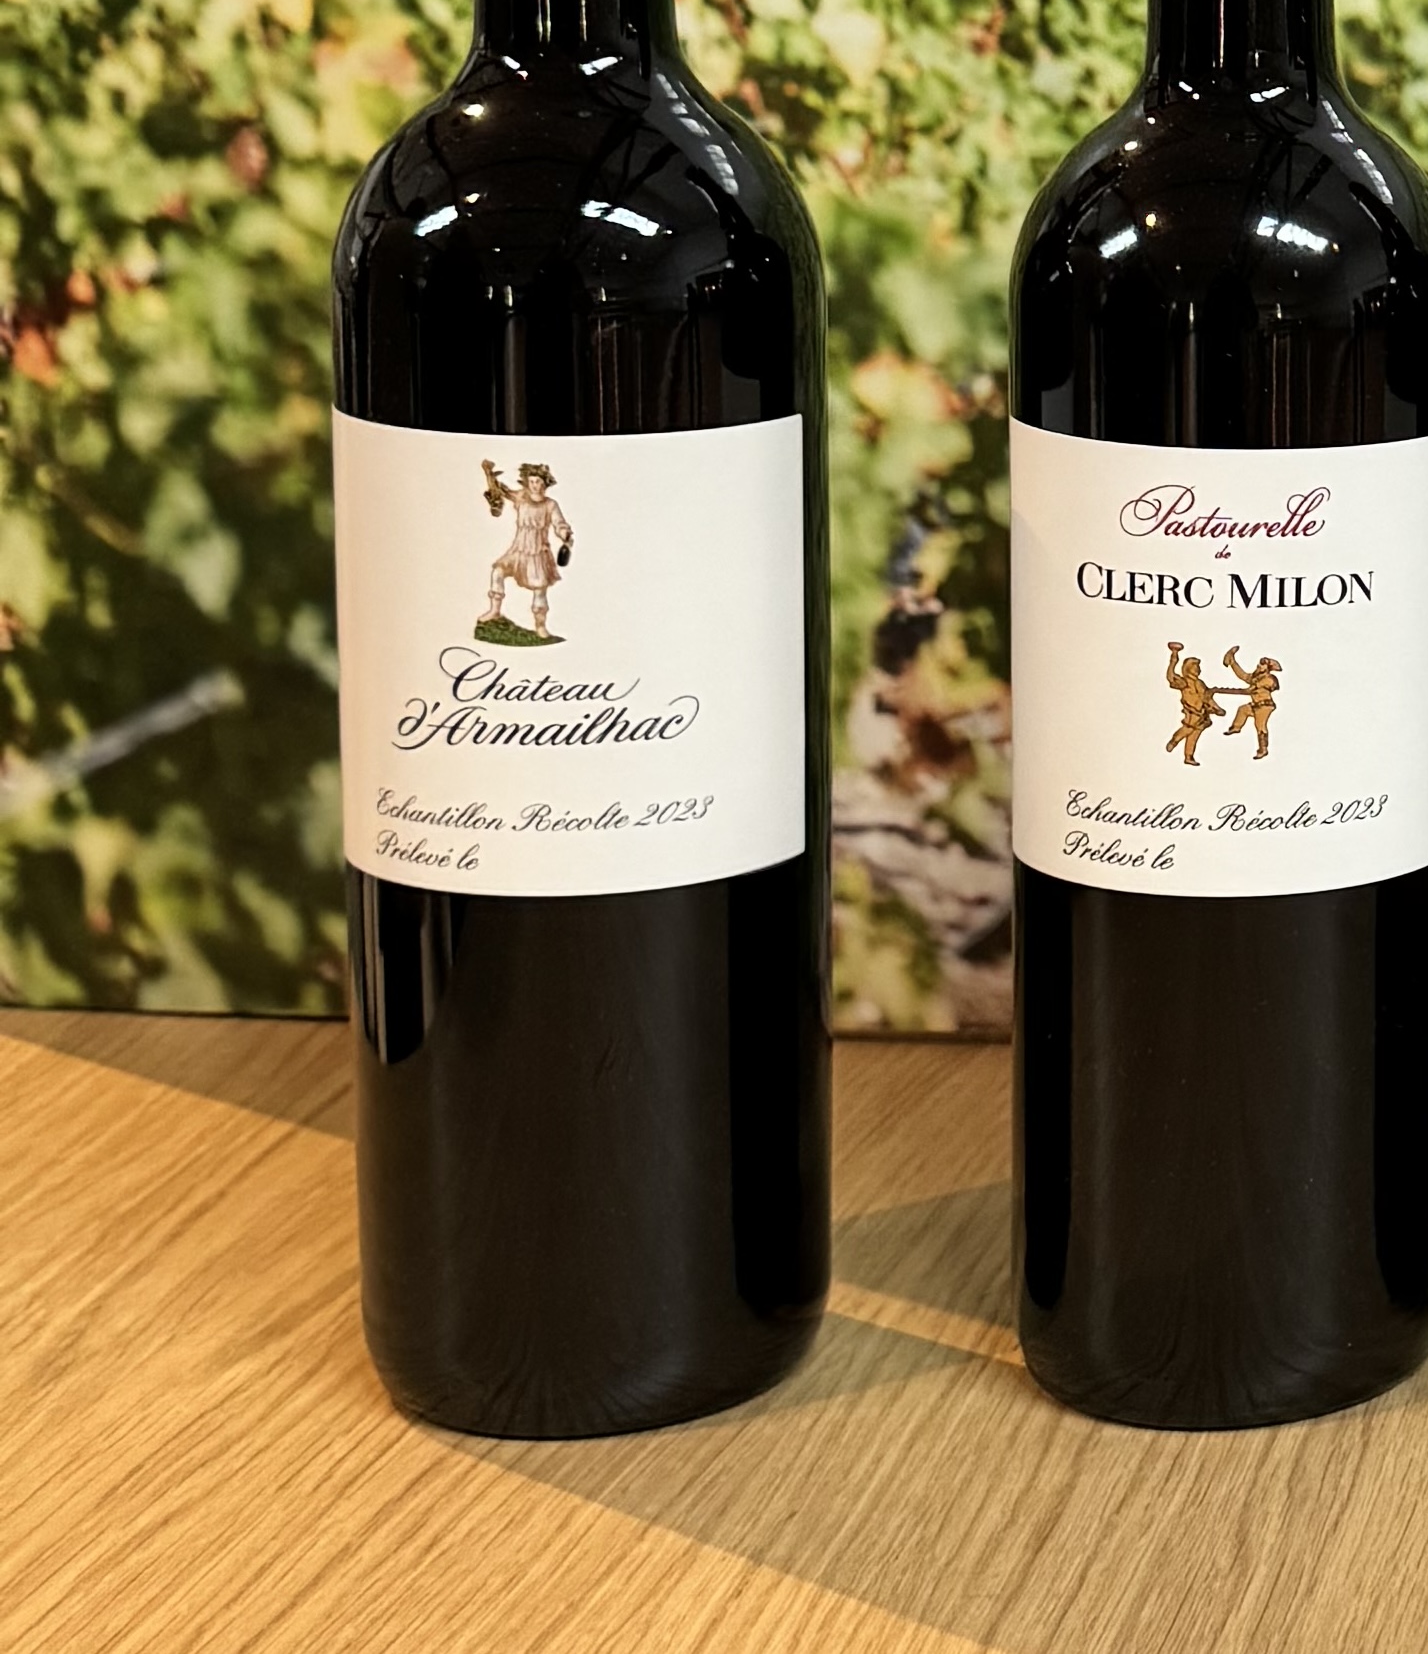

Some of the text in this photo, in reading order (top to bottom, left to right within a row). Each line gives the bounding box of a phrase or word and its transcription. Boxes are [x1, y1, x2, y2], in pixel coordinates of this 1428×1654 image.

[1119, 484, 1331, 539] Pastourelle
[1214, 544, 1232, 560] de
[1077, 561, 1375, 609] CLERC MILON
[439, 646, 641, 702] Château
[392, 695, 699, 750] d'Armailhac
[376, 787, 714, 833] Echantillon Récolte 2023
[1065, 788, 1389, 832] Echantillon Récolte 2023
[376, 829, 479, 870] Prélevé le
[1062, 829, 1175, 871] Prélevé le
